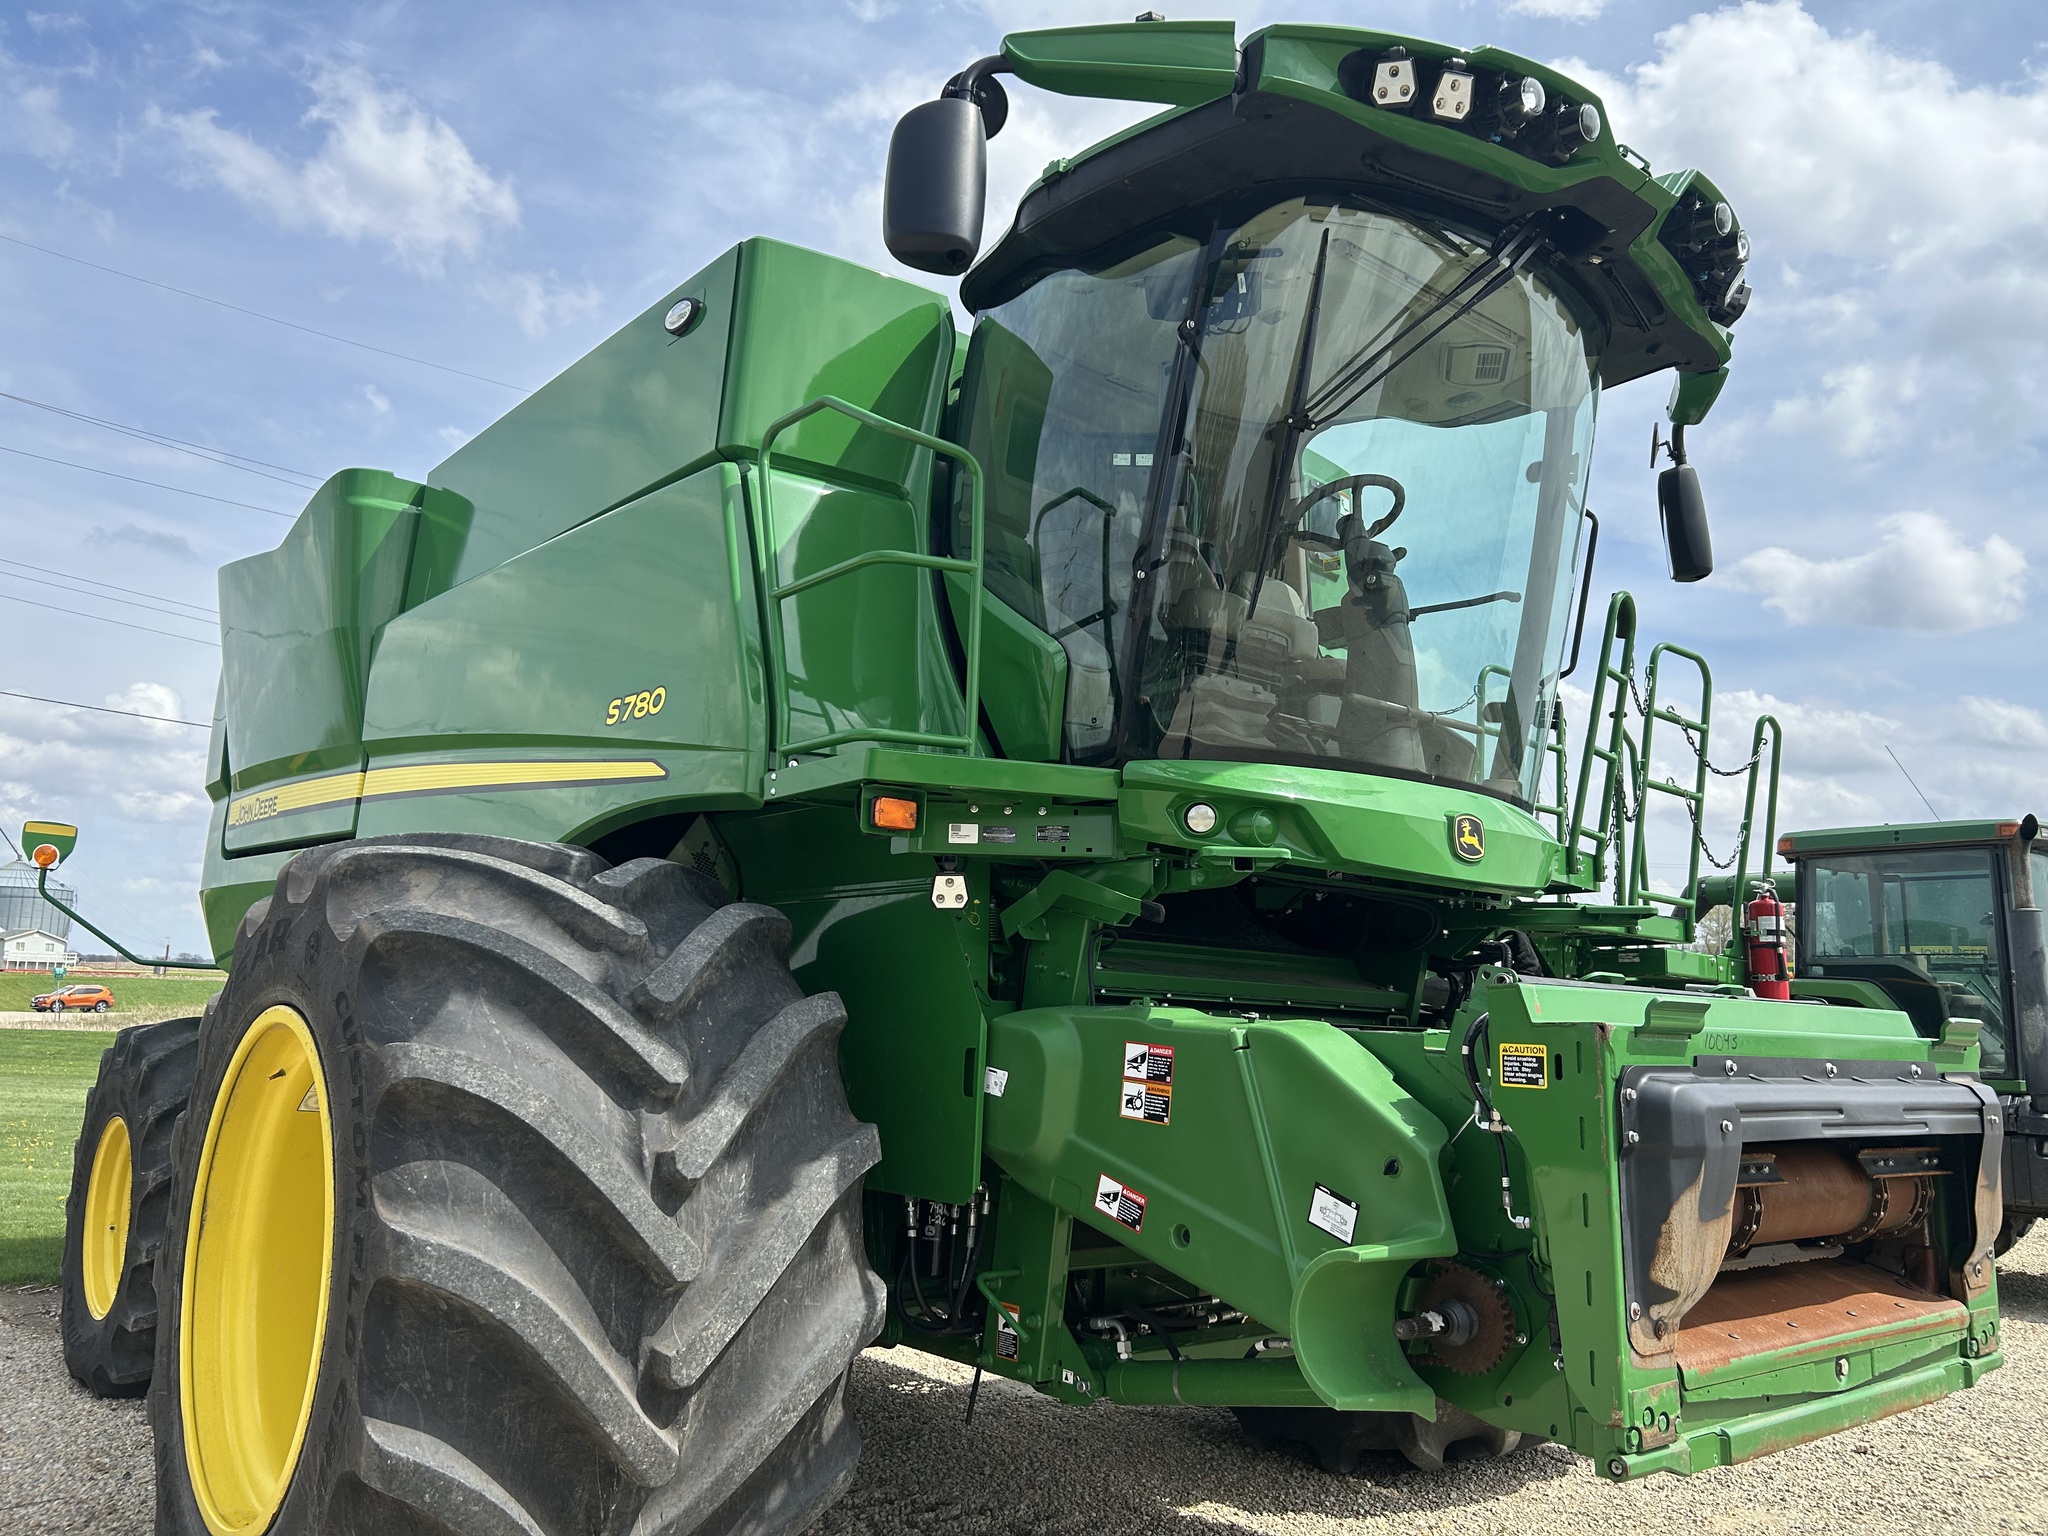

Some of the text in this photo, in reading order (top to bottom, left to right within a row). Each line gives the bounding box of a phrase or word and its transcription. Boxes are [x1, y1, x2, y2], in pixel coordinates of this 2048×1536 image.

[605, 685, 667, 726] S780
[236, 796, 278, 824] JOHN DEERE
[1154, 1047, 1172, 1055] DANGER
[1508, 1046, 1544, 1054] CAUTION
[1704, 1032, 1738, 1051] 10043
[335, 991, 367, 1209] CUSTOM
[1126, 1190, 1145, 1205] DANGER
